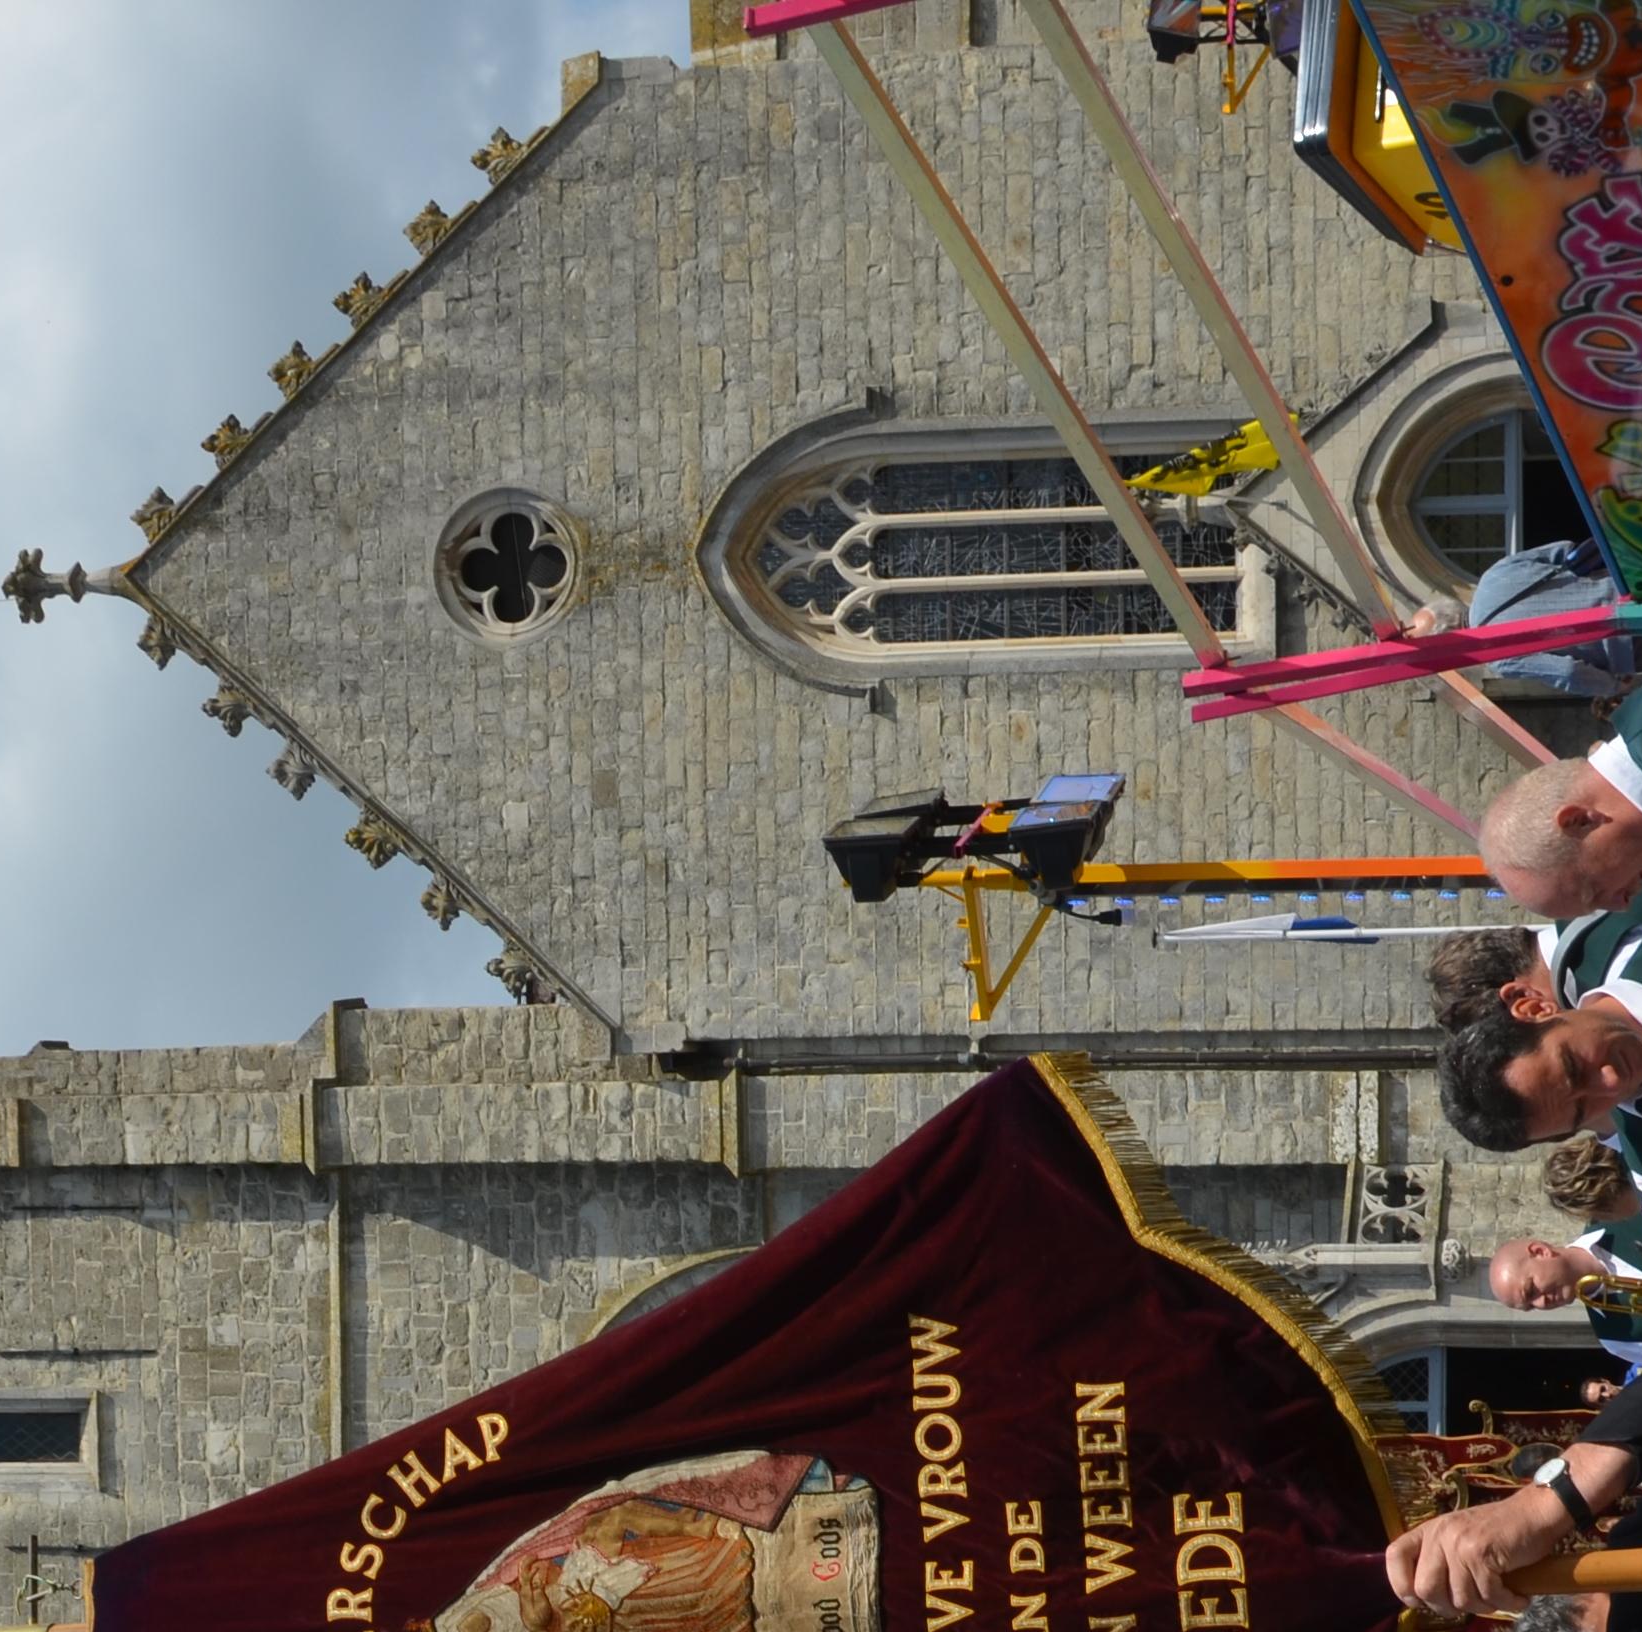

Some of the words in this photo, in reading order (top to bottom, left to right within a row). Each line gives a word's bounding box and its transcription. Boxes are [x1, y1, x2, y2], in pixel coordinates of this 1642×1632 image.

[908, 1312, 971, 1543] VROUW
[1075, 1381, 1138, 1594] WEEEN
[811, 1517, 843, 1582] Gods
[1005, 1500, 1047, 1572] DE
